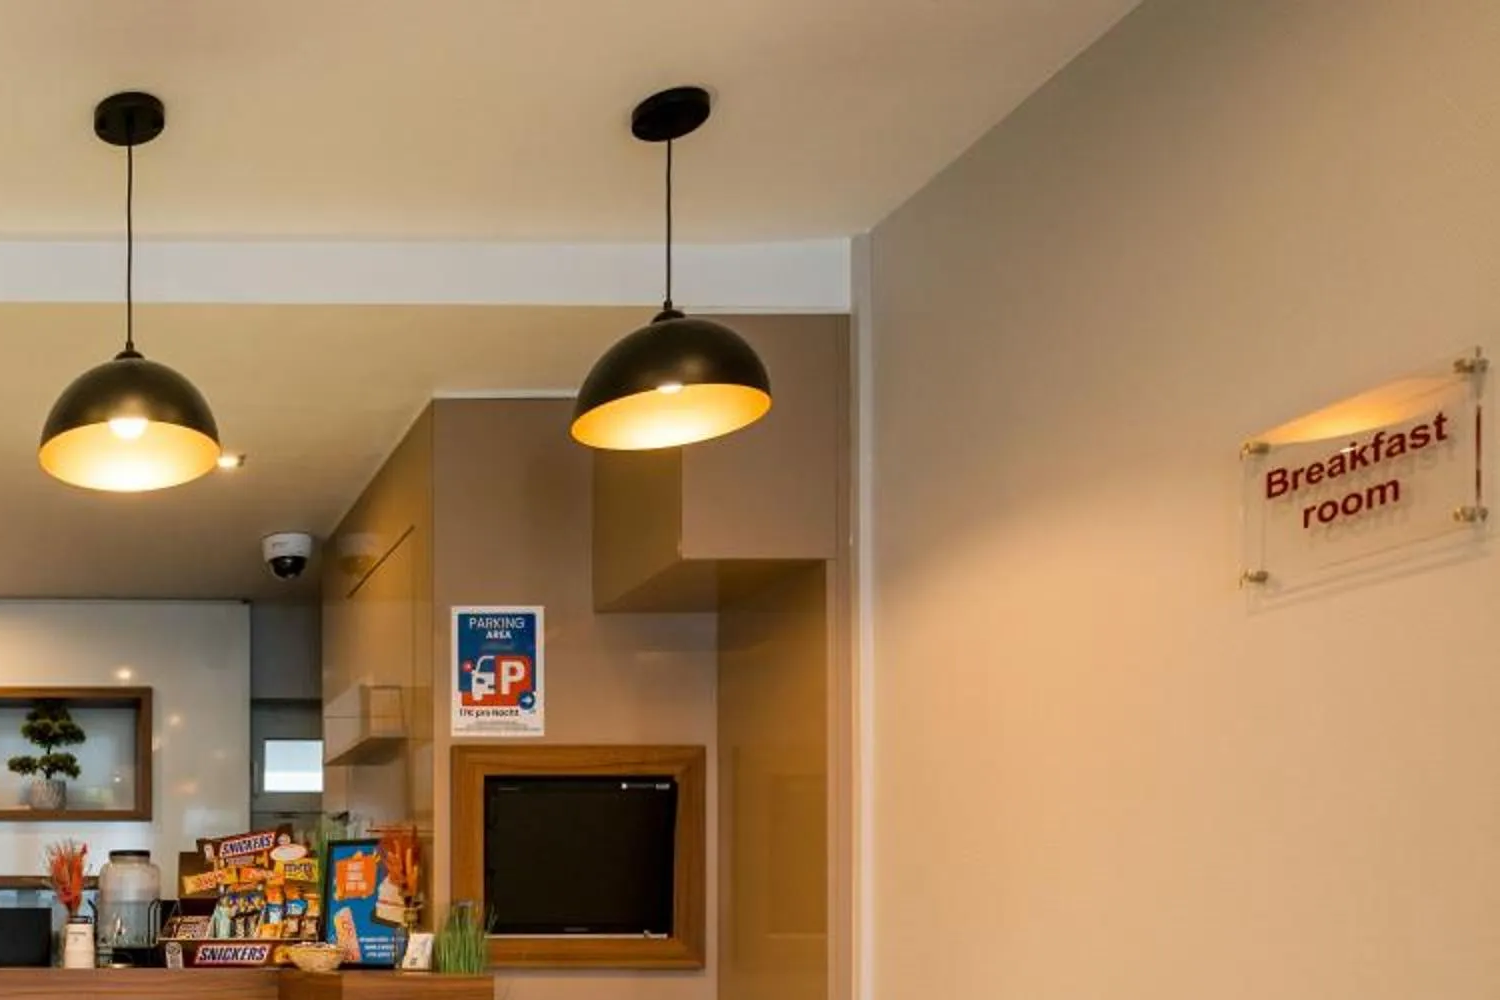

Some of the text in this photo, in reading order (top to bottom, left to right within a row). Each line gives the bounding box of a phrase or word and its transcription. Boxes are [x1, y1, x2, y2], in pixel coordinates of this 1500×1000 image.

[1266, 411, 1448, 499] Breakfast
[1303, 479, 1400, 529] room
[469, 617, 525, 629] PARKING
[486, 630, 512, 640] AREA
[501, 660, 525, 695] P
[222, 833, 271, 856] SNICKERS
[200, 946, 267, 961] SNICKERS
